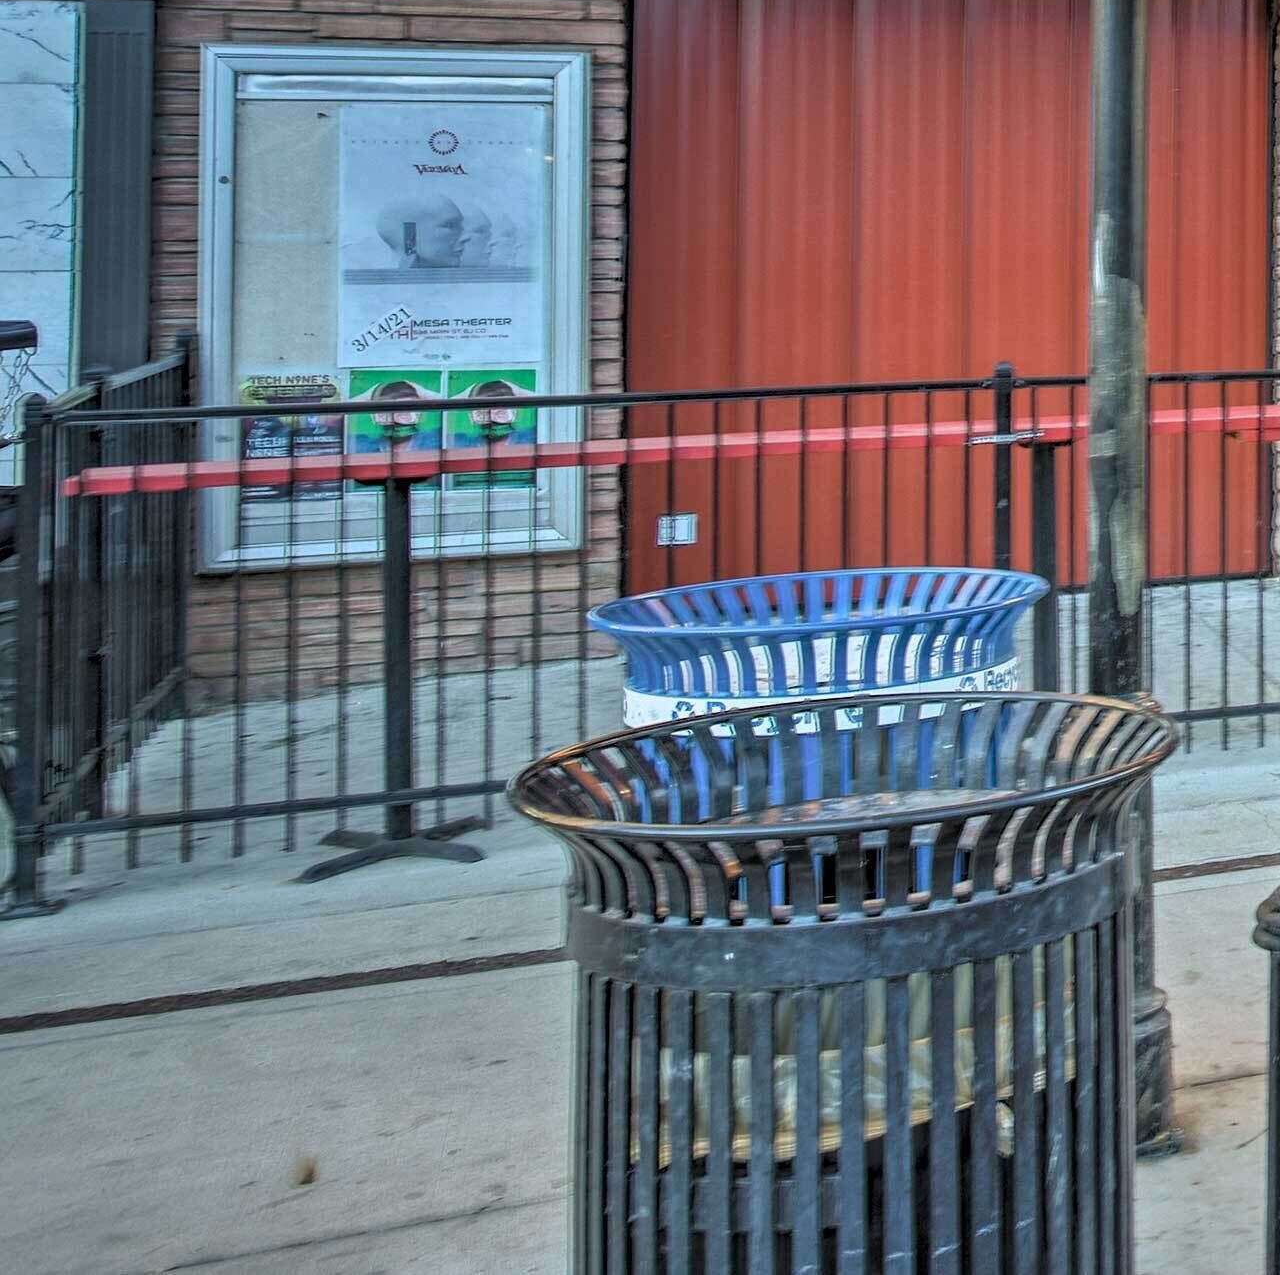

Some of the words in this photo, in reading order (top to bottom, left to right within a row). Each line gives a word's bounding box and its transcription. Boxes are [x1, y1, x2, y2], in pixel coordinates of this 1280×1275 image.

[413, 318, 450, 327] MESA
[453, 317, 512, 326] THEATER
[352, 308, 412, 353] 3/14/21
[250, 375, 281, 385] TECH
[285, 374, 330, 385] N9NE'S
